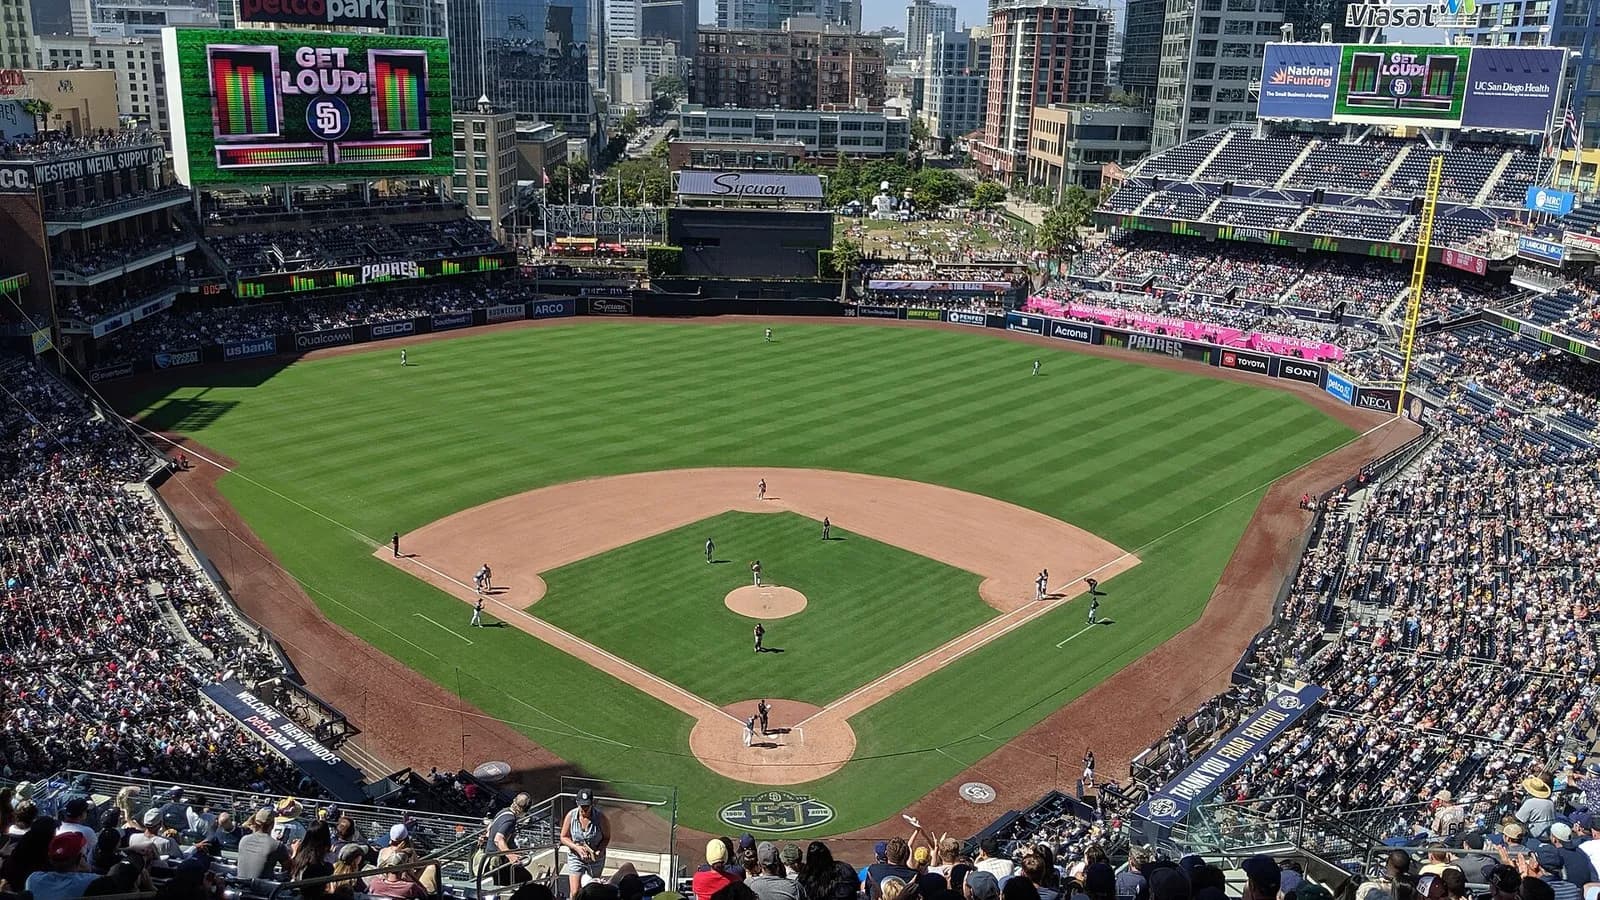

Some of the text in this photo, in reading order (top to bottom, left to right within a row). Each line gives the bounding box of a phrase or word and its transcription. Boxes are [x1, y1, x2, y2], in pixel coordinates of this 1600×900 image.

[1351, 4, 1435, 27] Viasat
[296, 46, 349, 68] GET
[1391, 53, 1418, 63] GET
[1287, 66, 1333, 76] National
[1382, 64, 1425, 76] LOUD!
[281, 69, 369, 95] LOUD!
[1287, 75, 1331, 87] Funding
[1474, 81, 1550, 94] UC San Diego Health
[35, 147, 166, 183] WESTERN METAL SUPPLY CO.
[711, 174, 788, 200] Sycuan
[361, 260, 418, 284] PADRES
[535, 303, 564, 314] ARCO
[593, 300, 626, 312] Sycuan
[373, 322, 413, 336] GEICO
[1055, 325, 1088, 339] Acronis
[1128, 334, 1184, 359] PADRES
[1261, 335, 1283, 346] HOME
[1300, 340, 1321, 350] DECK
[1237, 357, 1266, 369] TOYOTA
[1285, 366, 1319, 379] SONY
[1360, 395, 1392, 410] NECA
[236, 690, 281, 721] WELCOME
[279, 722, 342, 766] BIENVENIDOS
[1170, 708, 1290, 800] THANK YOU FRIAR FAITHFUL
